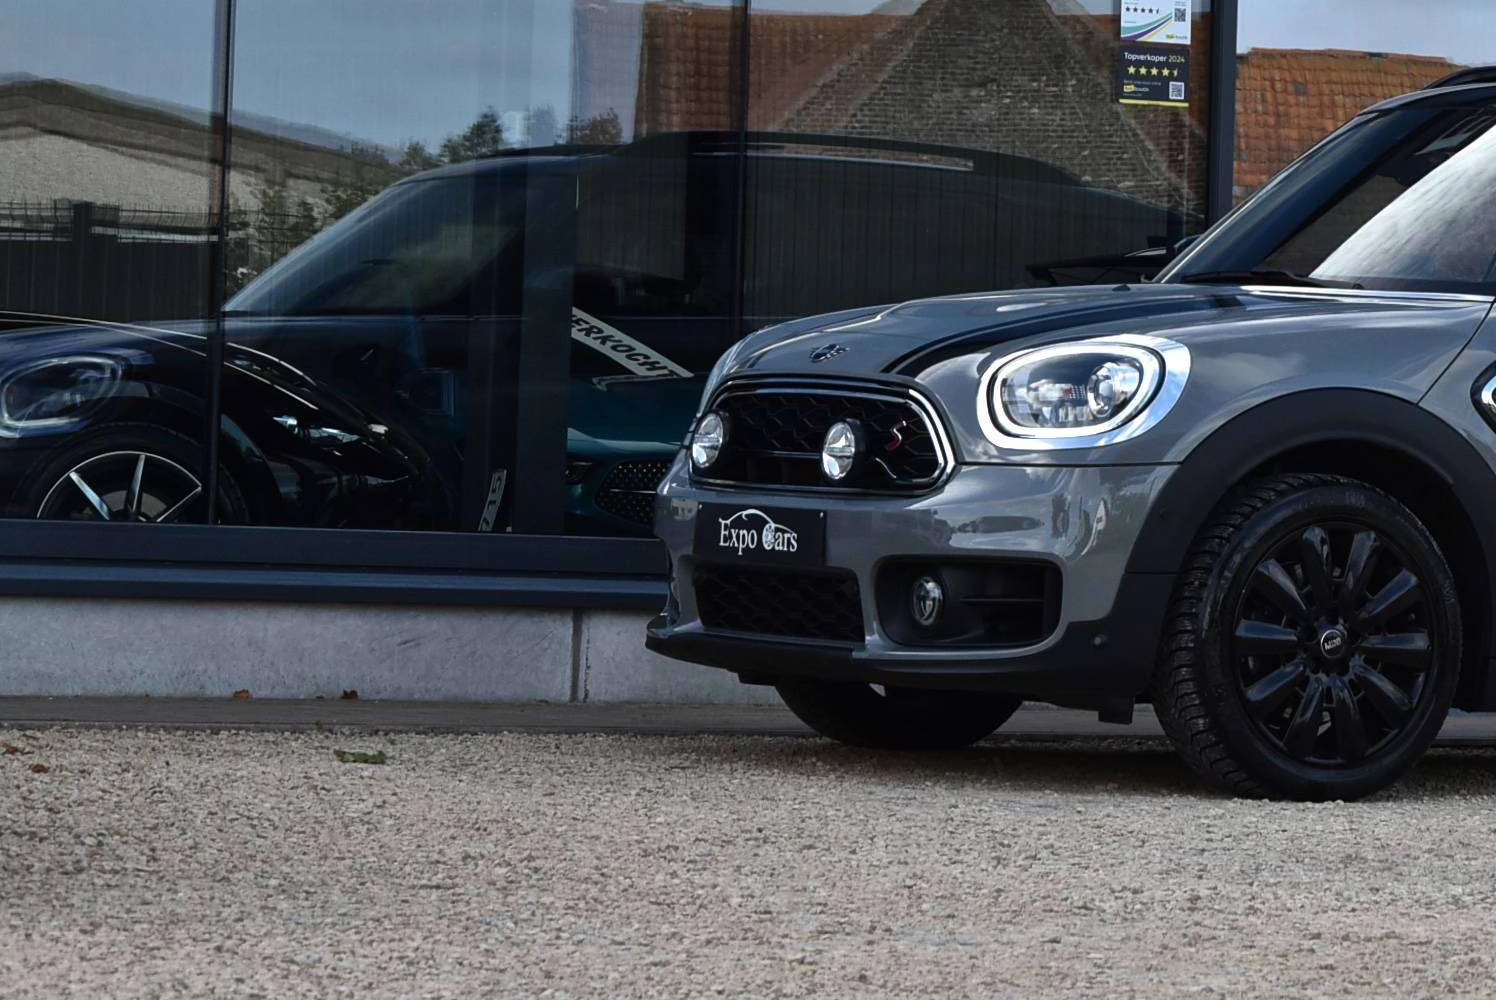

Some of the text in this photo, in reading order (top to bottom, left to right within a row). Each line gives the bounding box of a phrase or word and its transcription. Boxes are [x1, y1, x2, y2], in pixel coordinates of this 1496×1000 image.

[1124, 52, 1167, 62] Topverkoper
[571, 314, 679, 377] ERKOCHT
[718, 518, 797, 555] Expo Cars
